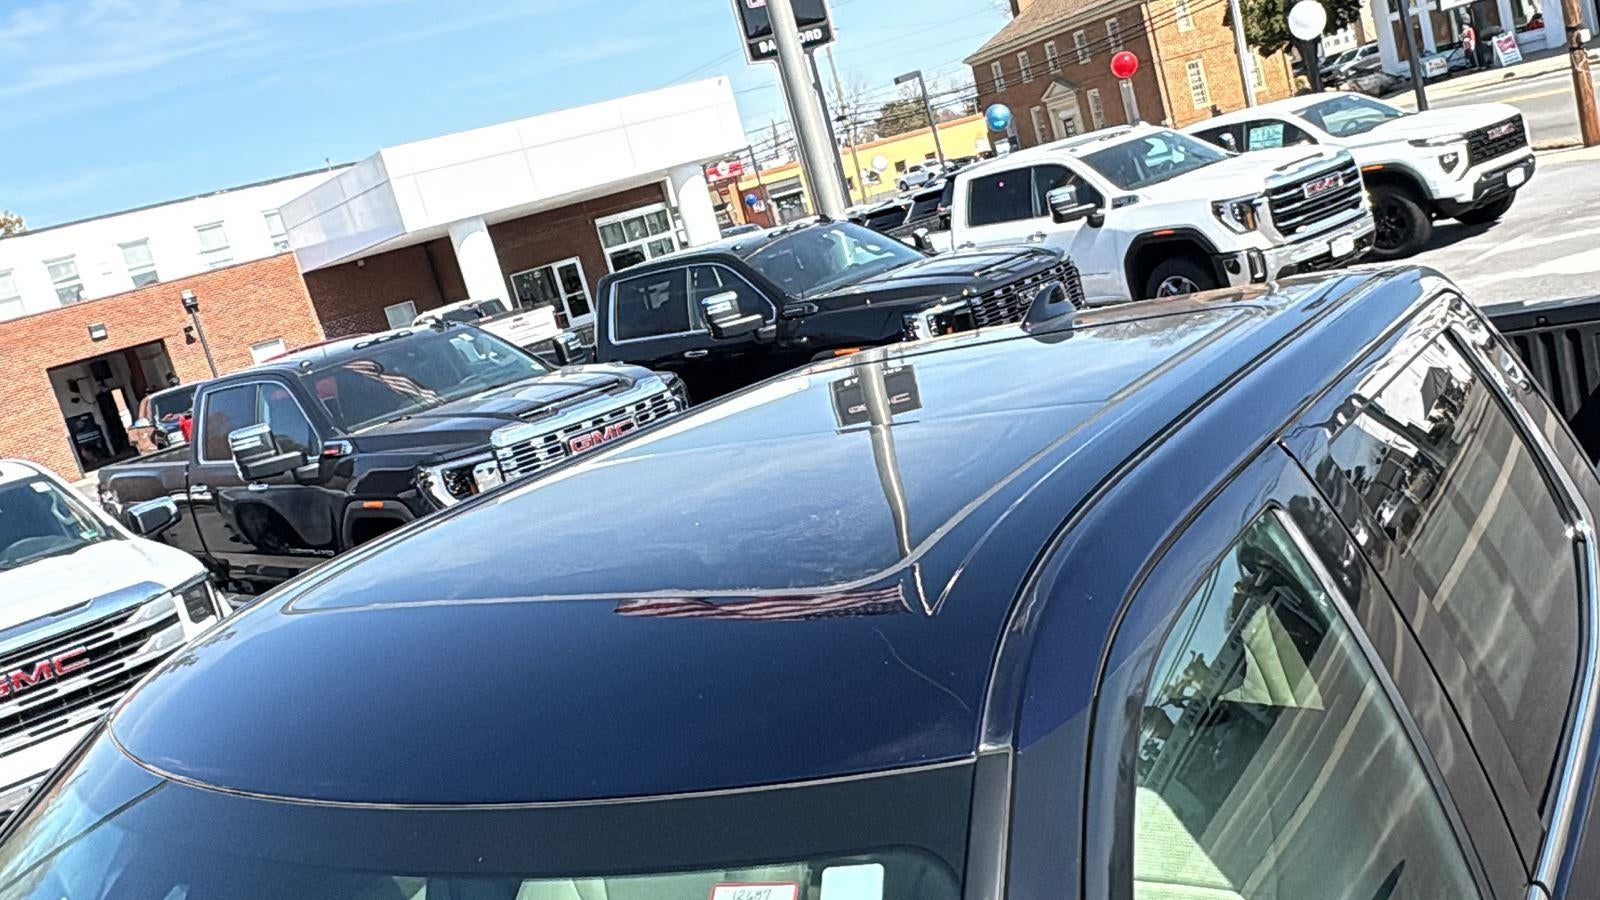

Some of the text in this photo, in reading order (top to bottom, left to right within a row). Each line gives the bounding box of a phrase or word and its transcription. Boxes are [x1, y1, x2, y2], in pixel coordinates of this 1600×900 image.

[758, 28, 823, 54] BAORD
[569, 418, 635, 454] GMC
[0, 646, 90, 697] MC
